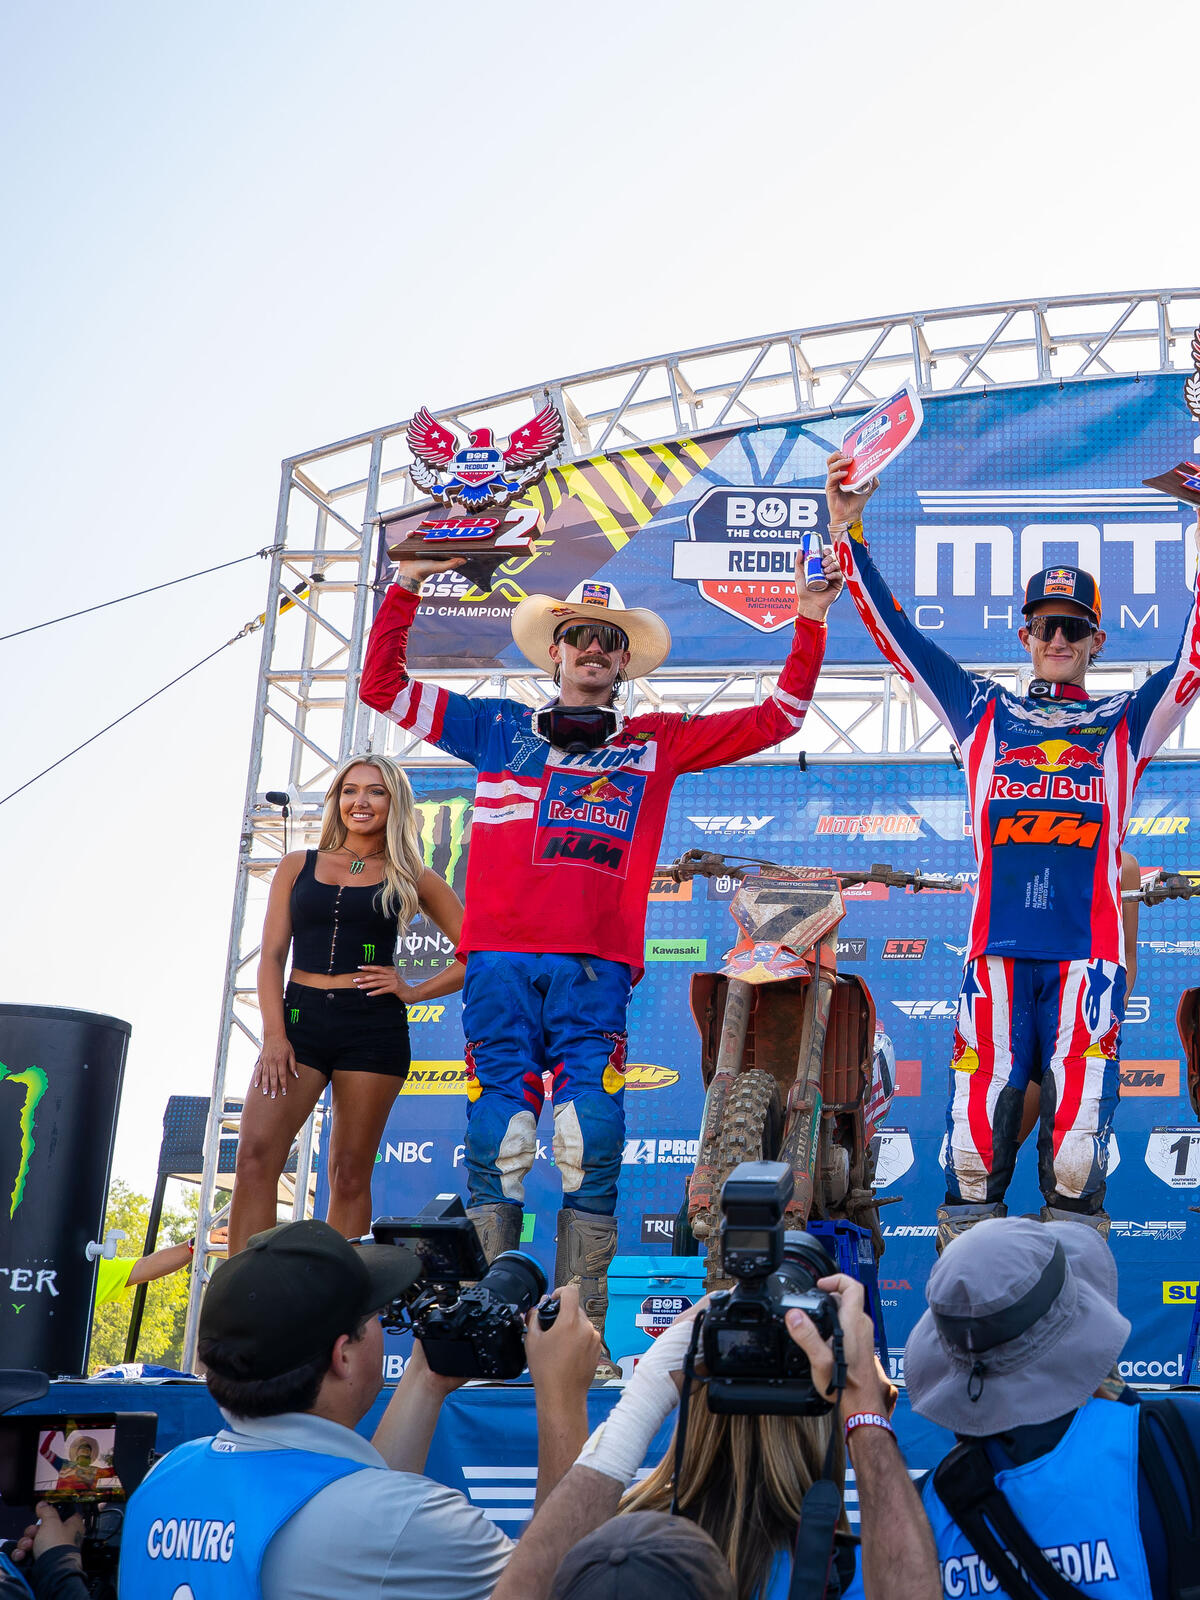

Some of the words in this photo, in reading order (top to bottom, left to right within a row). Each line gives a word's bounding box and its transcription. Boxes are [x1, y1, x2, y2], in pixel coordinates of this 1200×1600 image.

[726, 497, 819, 527] BOB
[421, 518, 500, 531] RED
[494, 508, 546, 549] 2
[411, 526, 494, 542] BUD
[727, 529, 750, 538] THE
[753, 529, 800, 539] COOLER
[728, 550, 796, 572] REDBU
[717, 585, 796, 594] NATION
[745, 596, 795, 604] BUCHANAN
[438, 606, 516, 618] CHAMPION
[505, 731, 545, 772] 7
[989, 775, 1049, 800] Red
[1051, 776, 1106, 804] Bull
[548, 800, 590, 822] Red
[590, 805, 630, 833] Bull
[687, 815, 775, 831] FLY
[991, 808, 1101, 850] KTM
[1127, 817, 1190, 835] THOR
[540, 830, 624, 870] KTM
[750, 891, 834, 941] 7
[652, 946, 699, 955] Kawasaki
[885, 940, 925, 953] ETS
[399, 959, 456, 967] ENER
[1120, 1069, 1165, 1087] KTM
[386, 1142, 433, 1163] NBC
[657, 1140, 699, 1156] PRO
[657, 1156, 699, 1164] RACING
[882, 1226, 938, 1238] LANDM
[1110, 1221, 1187, 1229] ENSE
[1116, 1230, 1157, 1238] TAZER
[652, 1299, 683, 1310] BOB
[1117, 1354, 1184, 1377] acock
[146, 1517, 236, 1564] CONVRG
